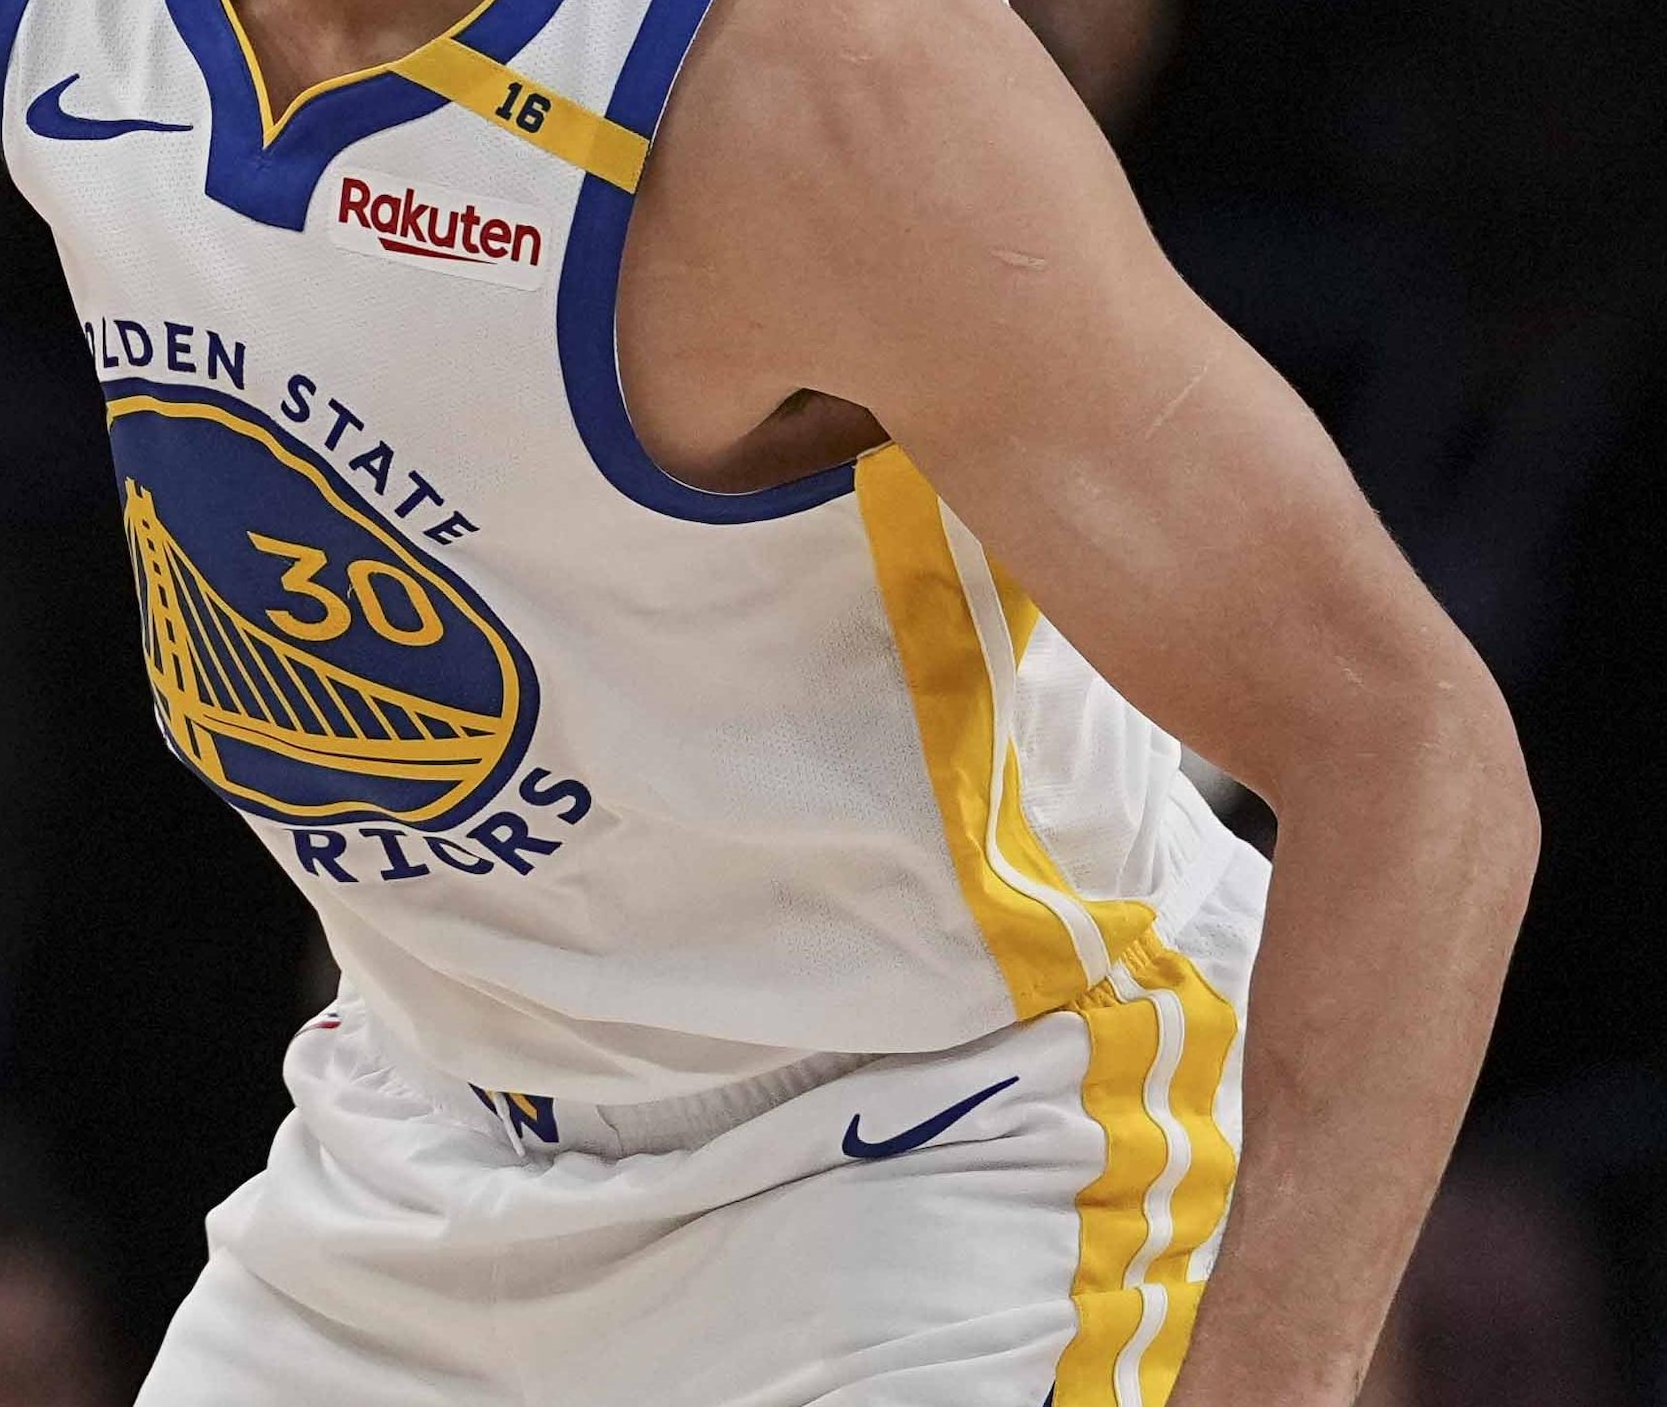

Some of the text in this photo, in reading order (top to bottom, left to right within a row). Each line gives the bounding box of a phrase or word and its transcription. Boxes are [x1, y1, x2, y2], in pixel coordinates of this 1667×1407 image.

[494, 81, 552, 134] 16
[338, 177, 542, 267] Rakuten
[280, 374, 481, 546] STATE
[246, 530, 444, 647] 30
[284, 767, 593, 883] RIORS
